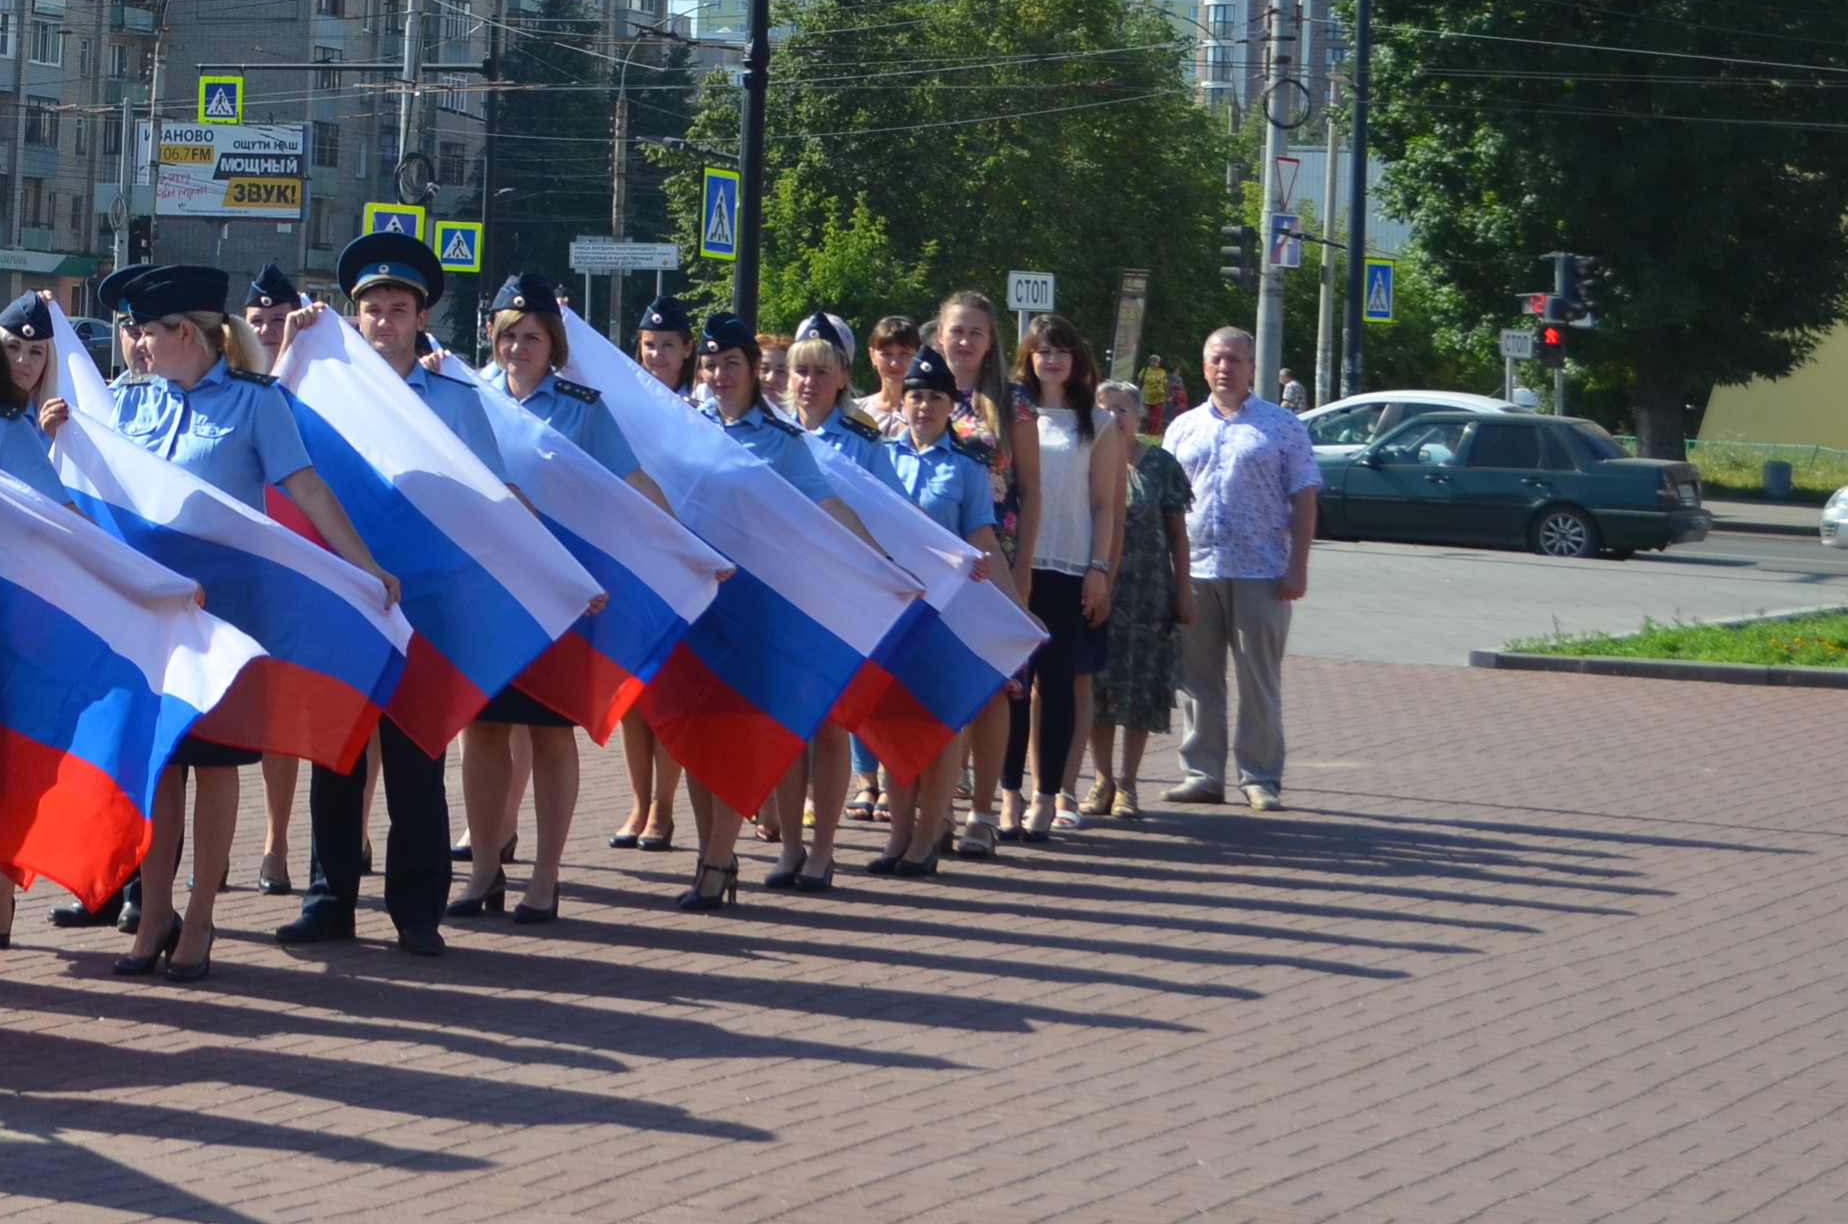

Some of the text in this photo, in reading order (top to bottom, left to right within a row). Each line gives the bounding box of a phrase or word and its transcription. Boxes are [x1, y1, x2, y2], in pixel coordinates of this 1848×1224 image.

[144, 129, 215, 143] ИАНОВО
[233, 140, 299, 151] ОЩУТИ НАШ
[220, 156, 298, 175] МОЩНЫЙ
[233, 183, 297, 205] ЗВУК!
[1015, 279, 1048, 304] СТОП
[1505, 334, 1528, 353] СТОП
